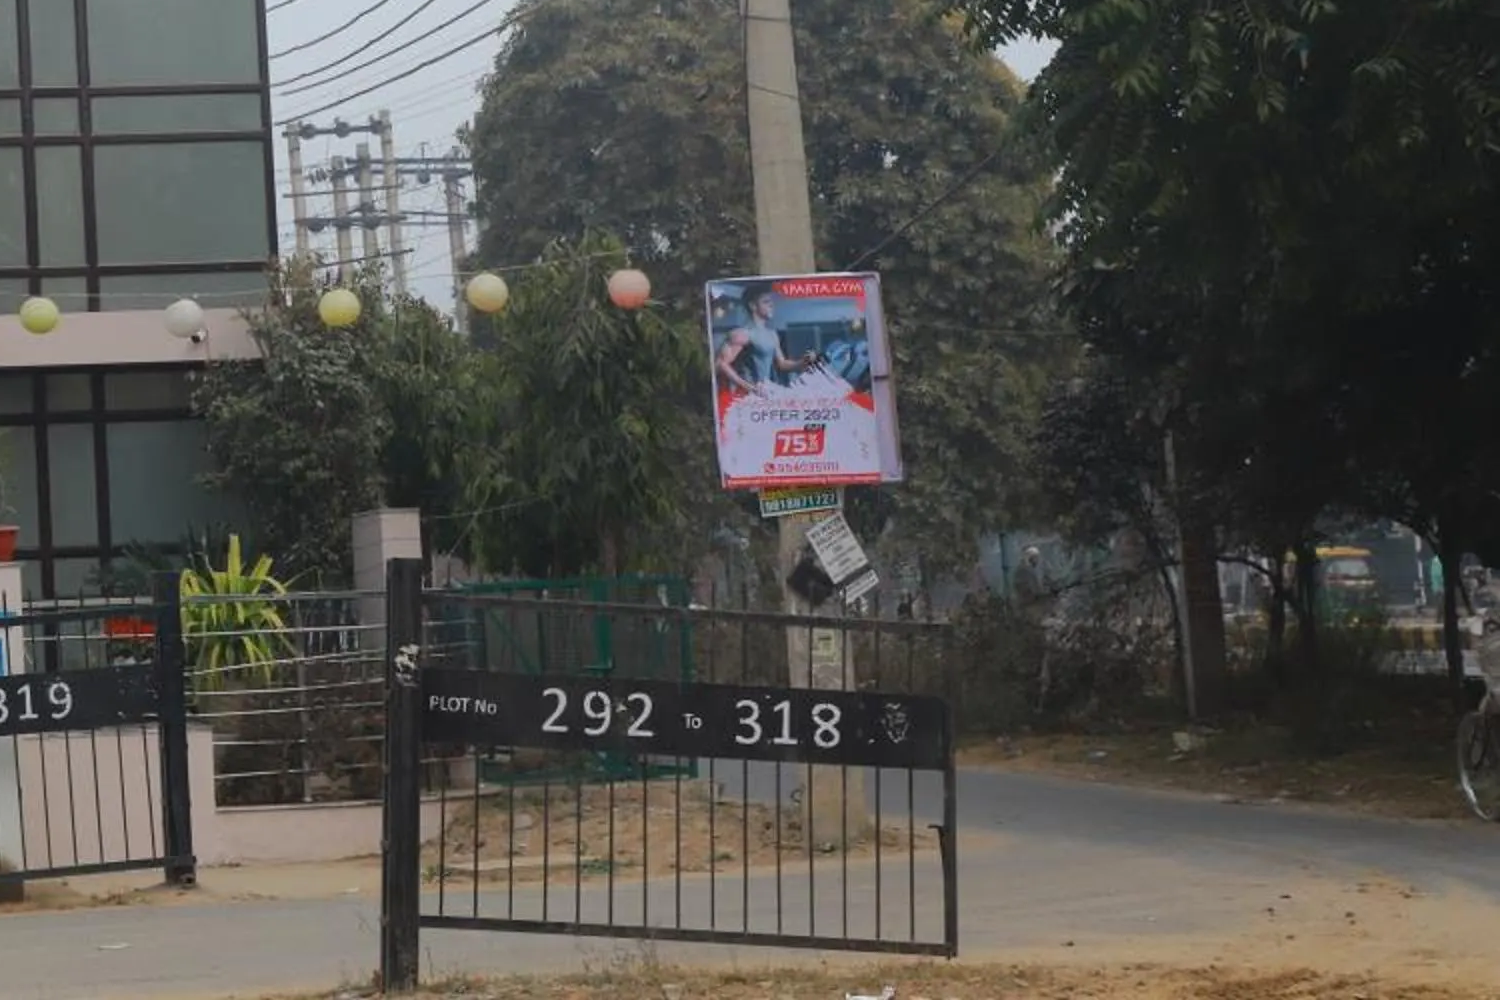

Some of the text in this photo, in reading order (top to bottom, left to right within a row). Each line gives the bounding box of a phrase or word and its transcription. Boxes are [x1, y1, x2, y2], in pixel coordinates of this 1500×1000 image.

[750, 409, 800, 422] OFFER
[429, 687, 841, 748] PLOT No 292 To 318
